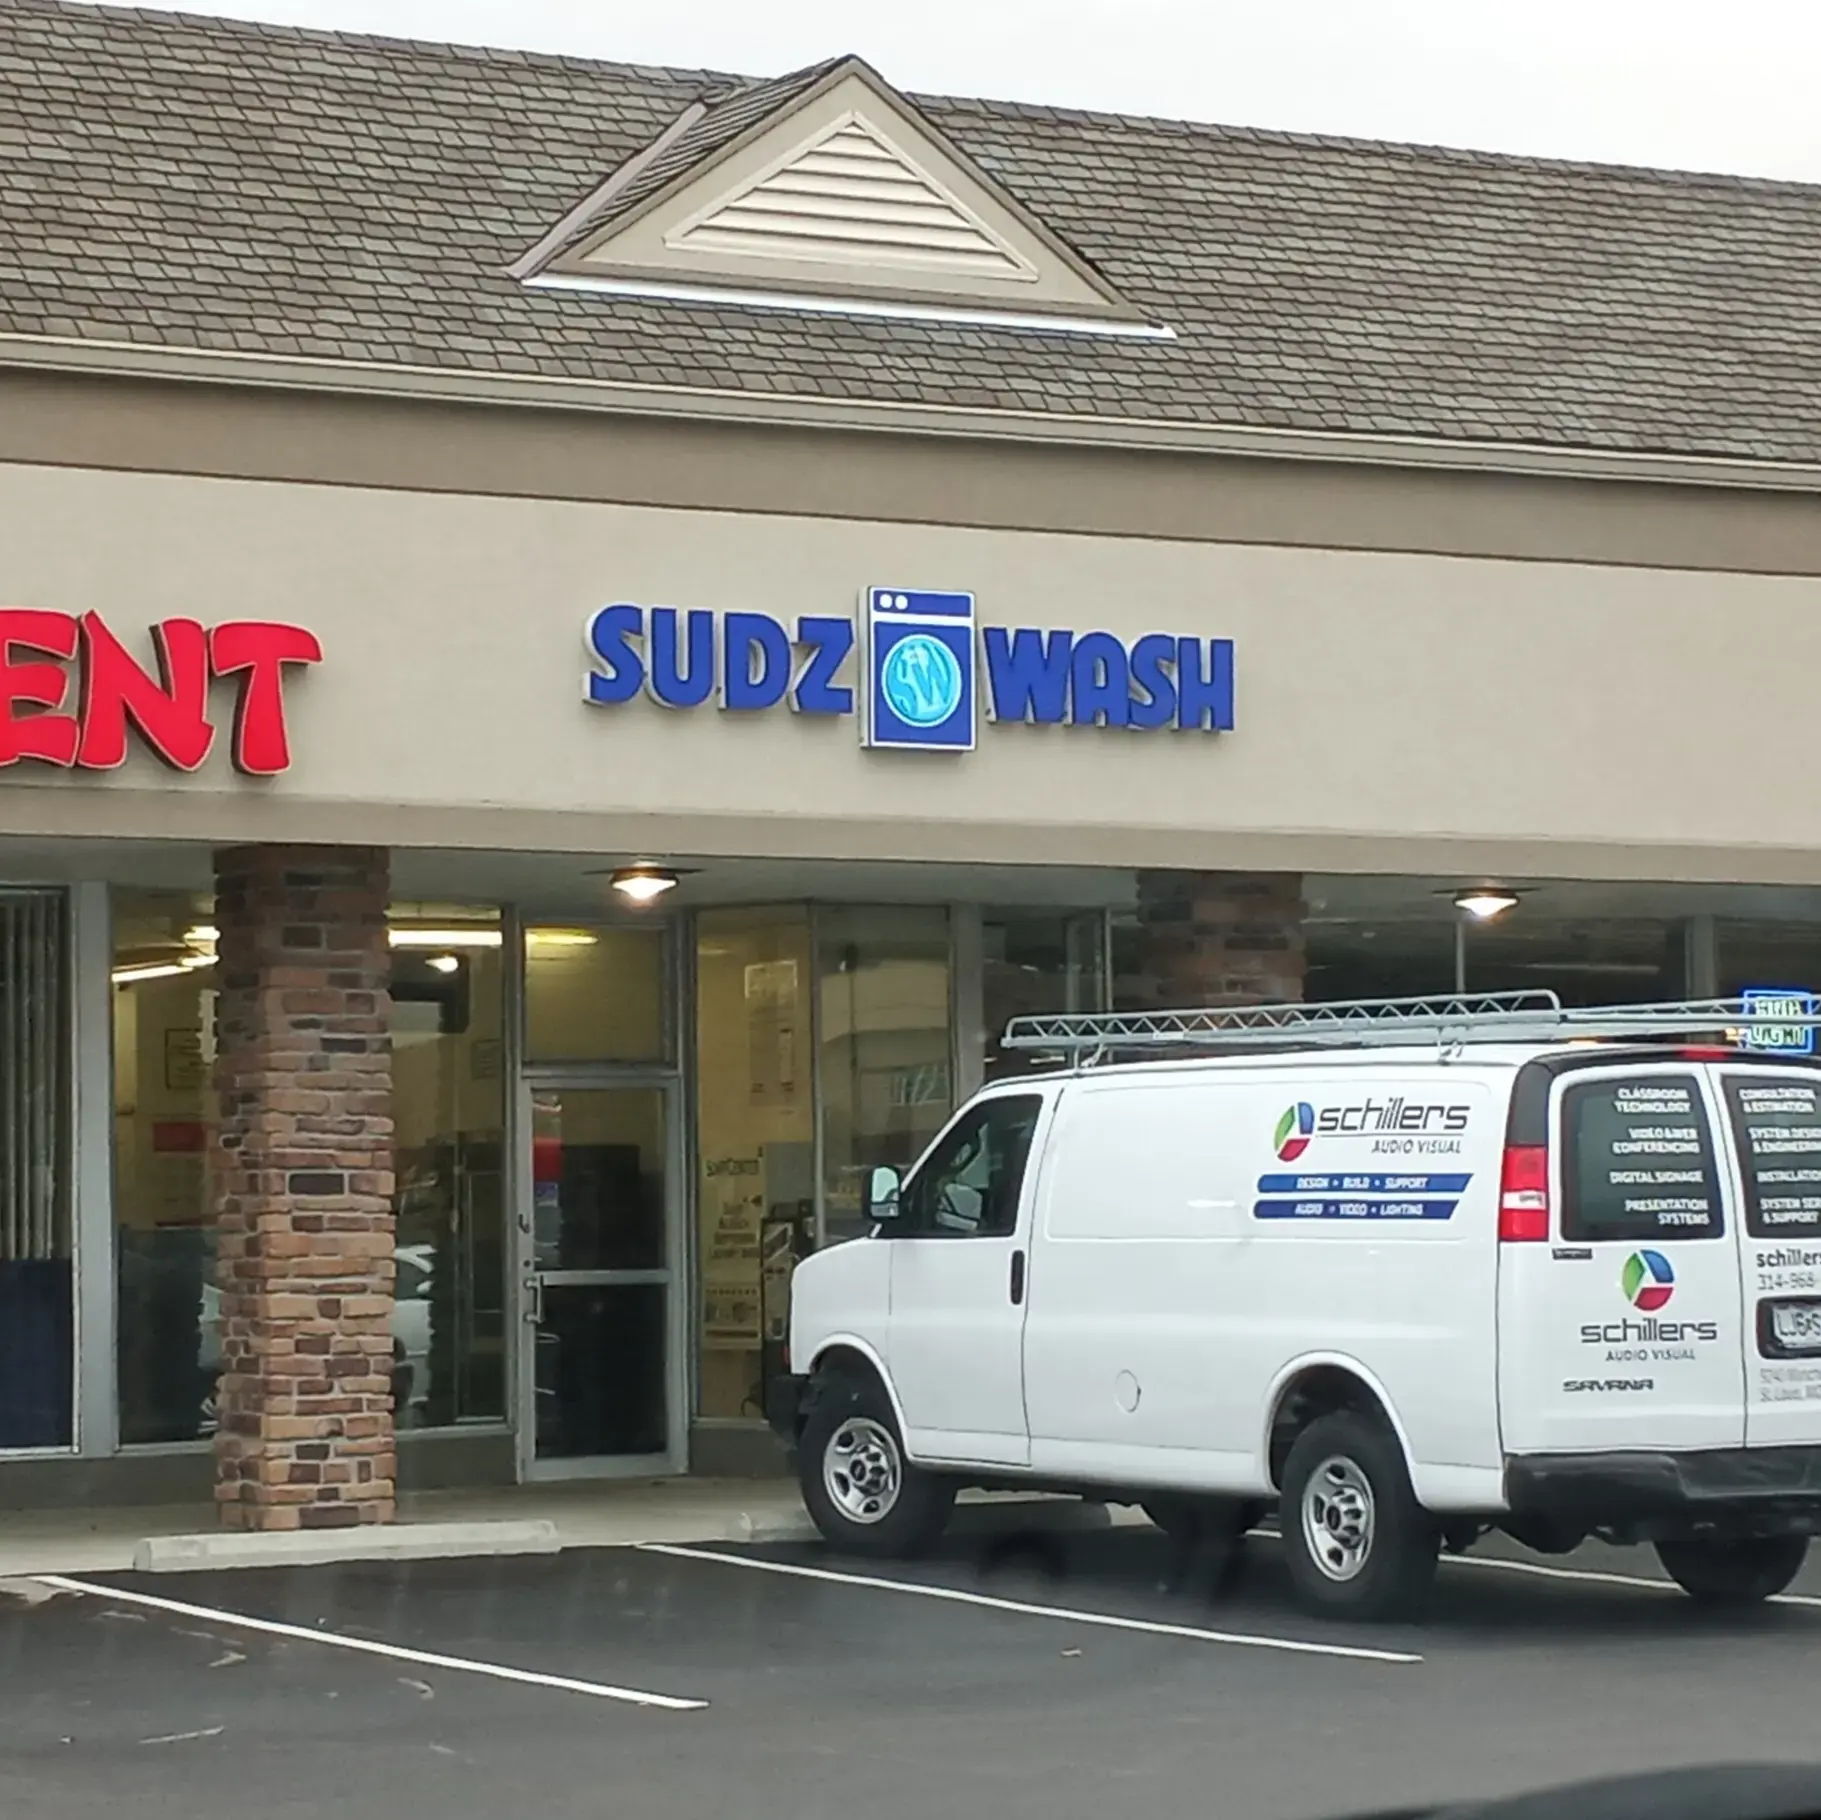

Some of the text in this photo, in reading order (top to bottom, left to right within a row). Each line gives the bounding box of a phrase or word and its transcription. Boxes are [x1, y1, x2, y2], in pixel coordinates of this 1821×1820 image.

[584, 603, 1236, 731] SUDZ WASH
[0, 605, 323, 775] ENT
[1613, 1100, 1692, 1113] TECHNOLOGY
[1317, 1097, 1471, 1132] schillers
[1371, 1139, 1462, 1154] AUDIO VISUAL
[1385, 1176, 1429, 1190] SUPPORT
[1609, 1171, 1655, 1184] DIGITAL
[1624, 1198, 1709, 1212] PRESENTATION
[1657, 1212, 1711, 1226] SYSTEMS
[1756, 1248, 1821, 1268] schiller
[1581, 1317, 1718, 1344] schillers
[1605, 1348, 1697, 1362] AUDIO VISUAL
[1563, 1378, 1654, 1393] SAVANA
